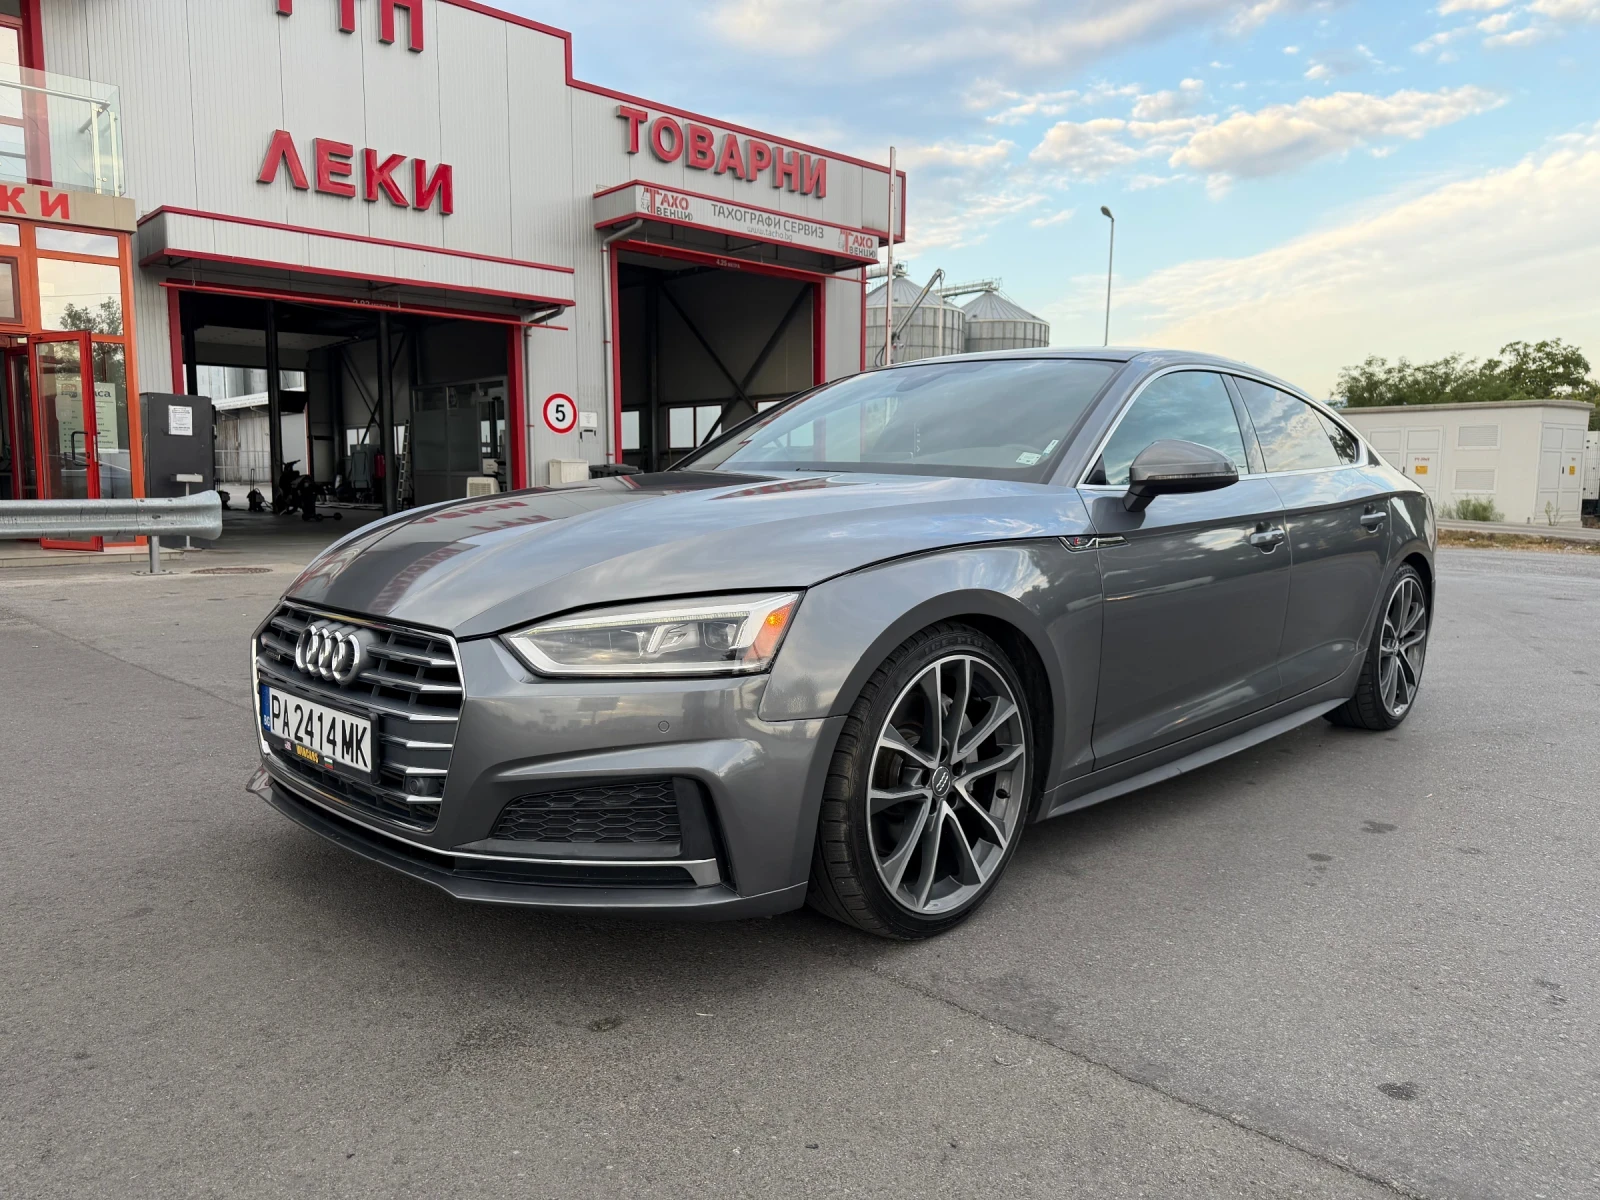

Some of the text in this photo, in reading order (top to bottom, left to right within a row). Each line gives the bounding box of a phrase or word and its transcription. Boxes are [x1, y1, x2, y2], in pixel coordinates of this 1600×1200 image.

[616, 104, 827, 198] ТОВАРНИ
[256, 129, 453, 215] ЛЕКИ
[643, 187, 690, 214] ТАХО
[711, 203, 824, 239] ТАХОГРАФИ СЕРВИЗ
[555, 404, 566, 422] 5
[263, 714, 271, 727] BG
